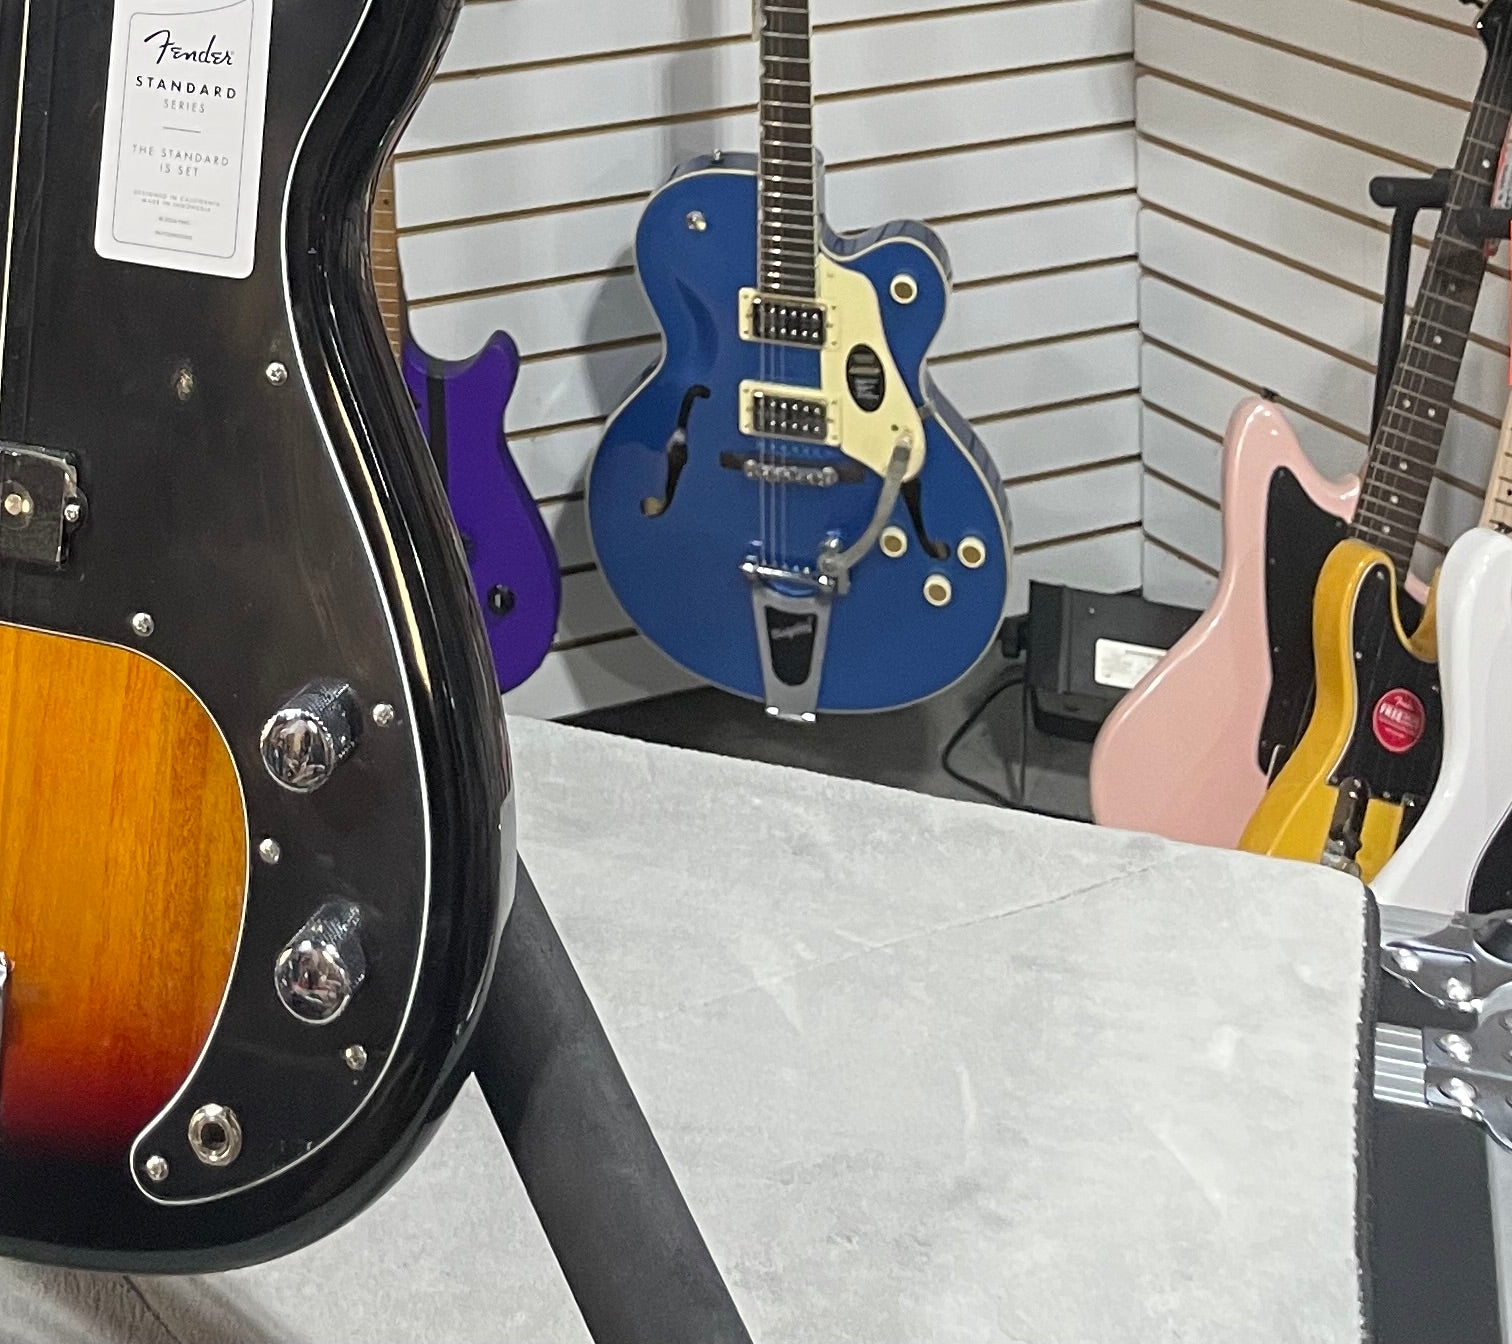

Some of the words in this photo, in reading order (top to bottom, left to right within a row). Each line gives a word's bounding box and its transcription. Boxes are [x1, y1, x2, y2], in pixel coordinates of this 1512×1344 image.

[144, 29, 234, 65] Fender
[136, 75, 237, 100] STANDARD
[163, 99, 205, 114] SERIES
[132, 143, 154, 157] THE
[161, 147, 229, 167] STANDARD
[160, 164, 171, 175] IS
[178, 166, 199, 177] SET
